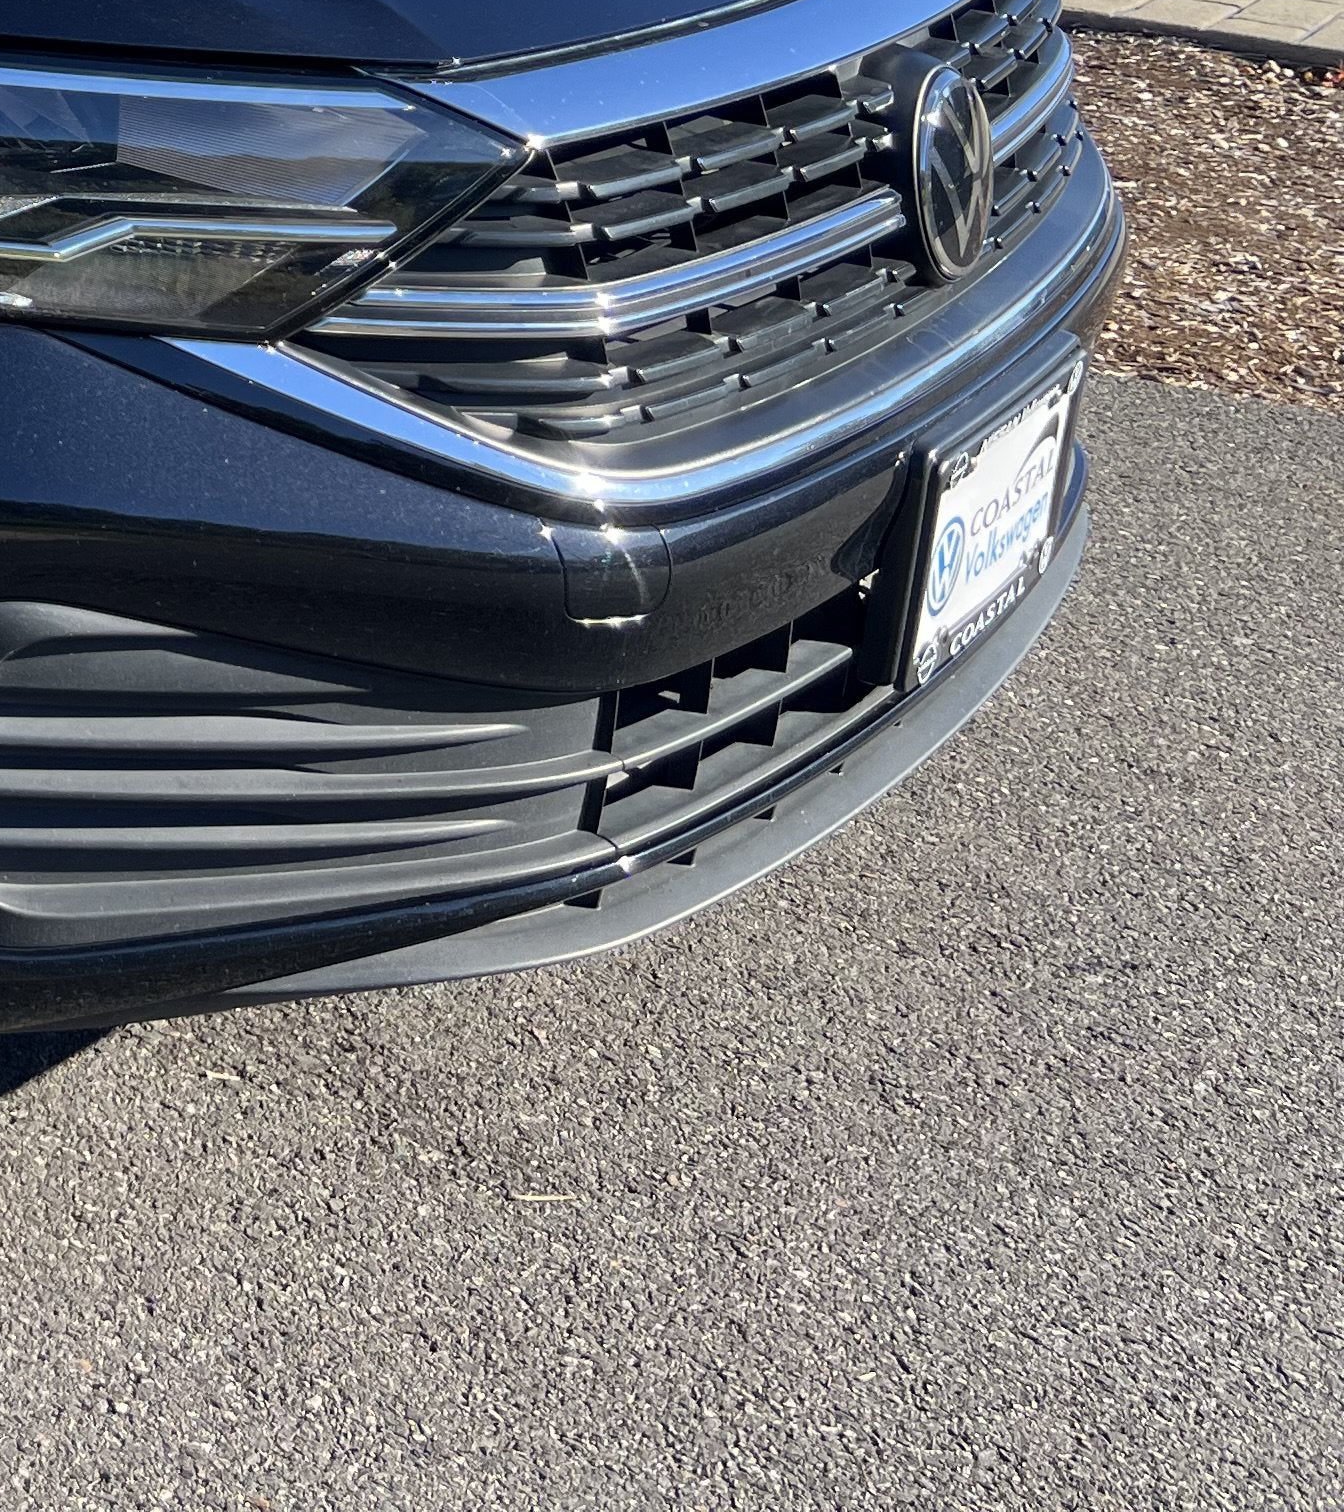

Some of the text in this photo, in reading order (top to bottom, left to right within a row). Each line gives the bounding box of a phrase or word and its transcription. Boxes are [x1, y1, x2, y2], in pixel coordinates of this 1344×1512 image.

[970, 447, 1056, 537] COASTAL
[964, 492, 1049, 585] Volkswagen
[949, 576, 1026, 656] COASTAL
